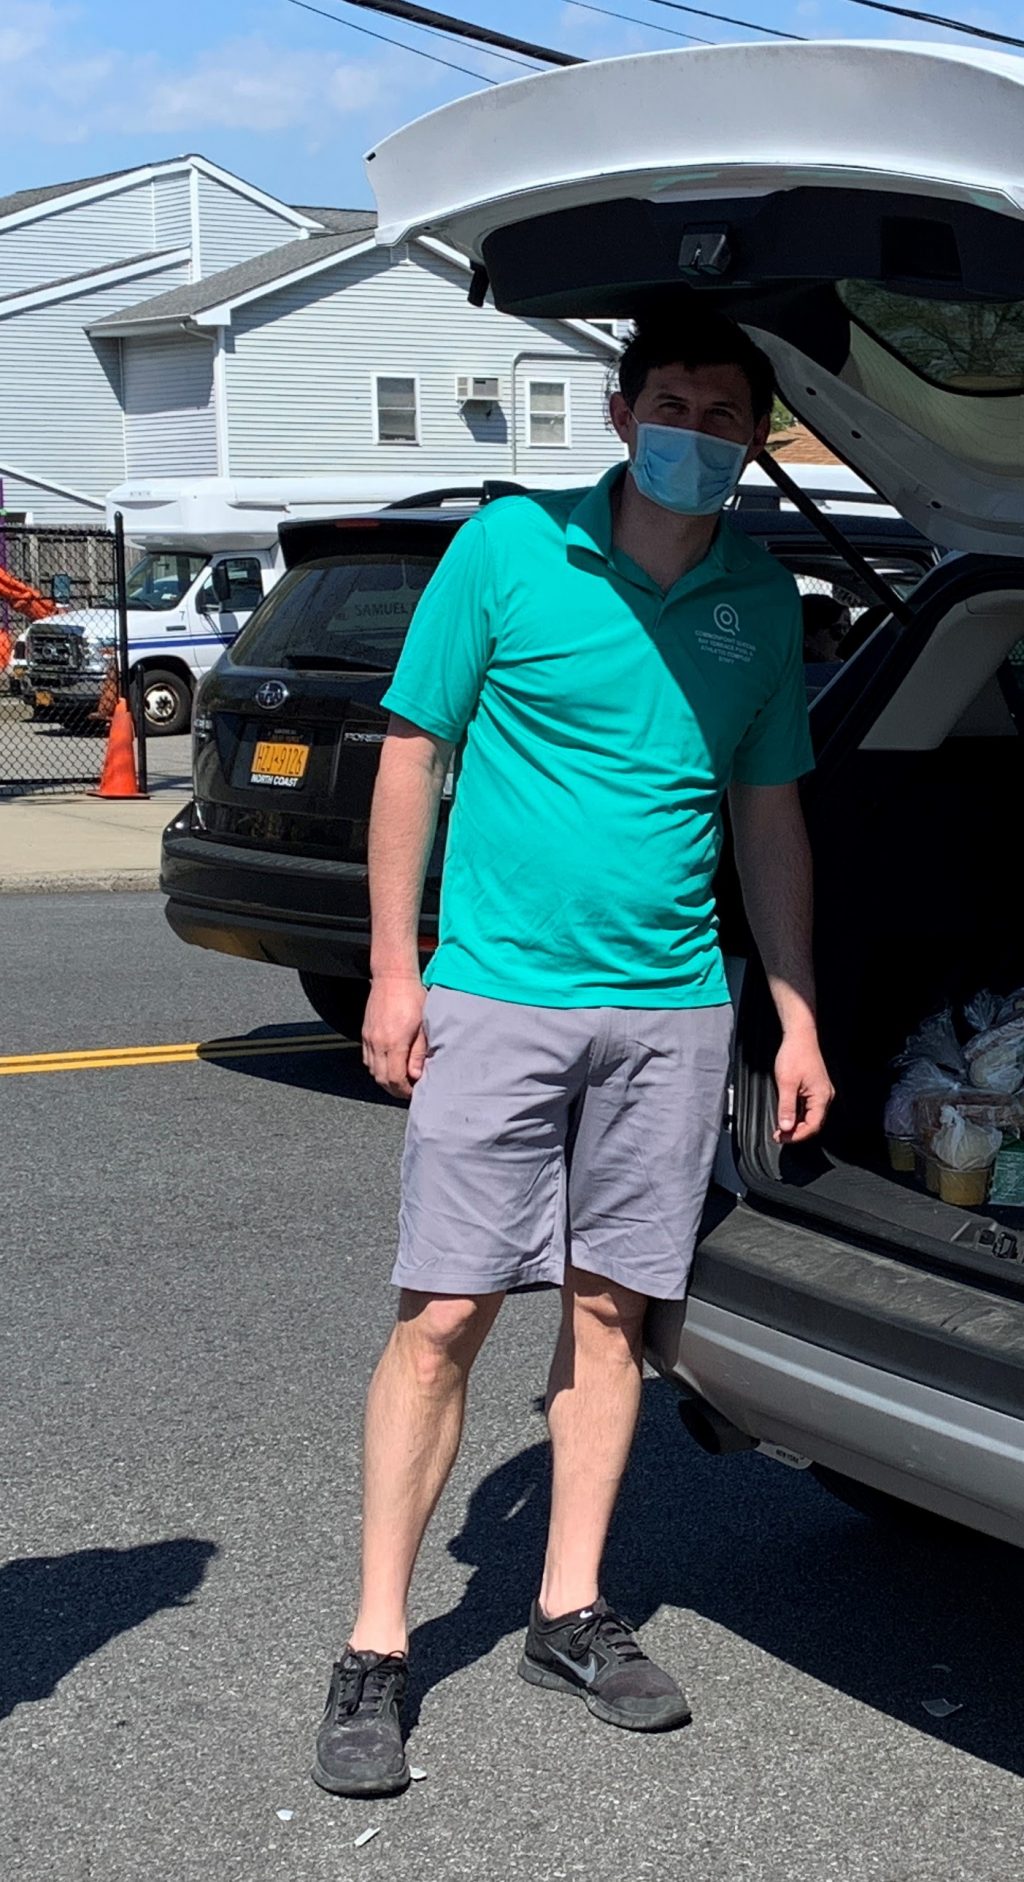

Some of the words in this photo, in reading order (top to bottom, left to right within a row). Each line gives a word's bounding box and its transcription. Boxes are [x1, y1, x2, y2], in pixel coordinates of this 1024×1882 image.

[354, 602, 408, 617] SAMUEL
[250, 773, 274, 785] NORTH
[273, 775, 299, 787] COAST
